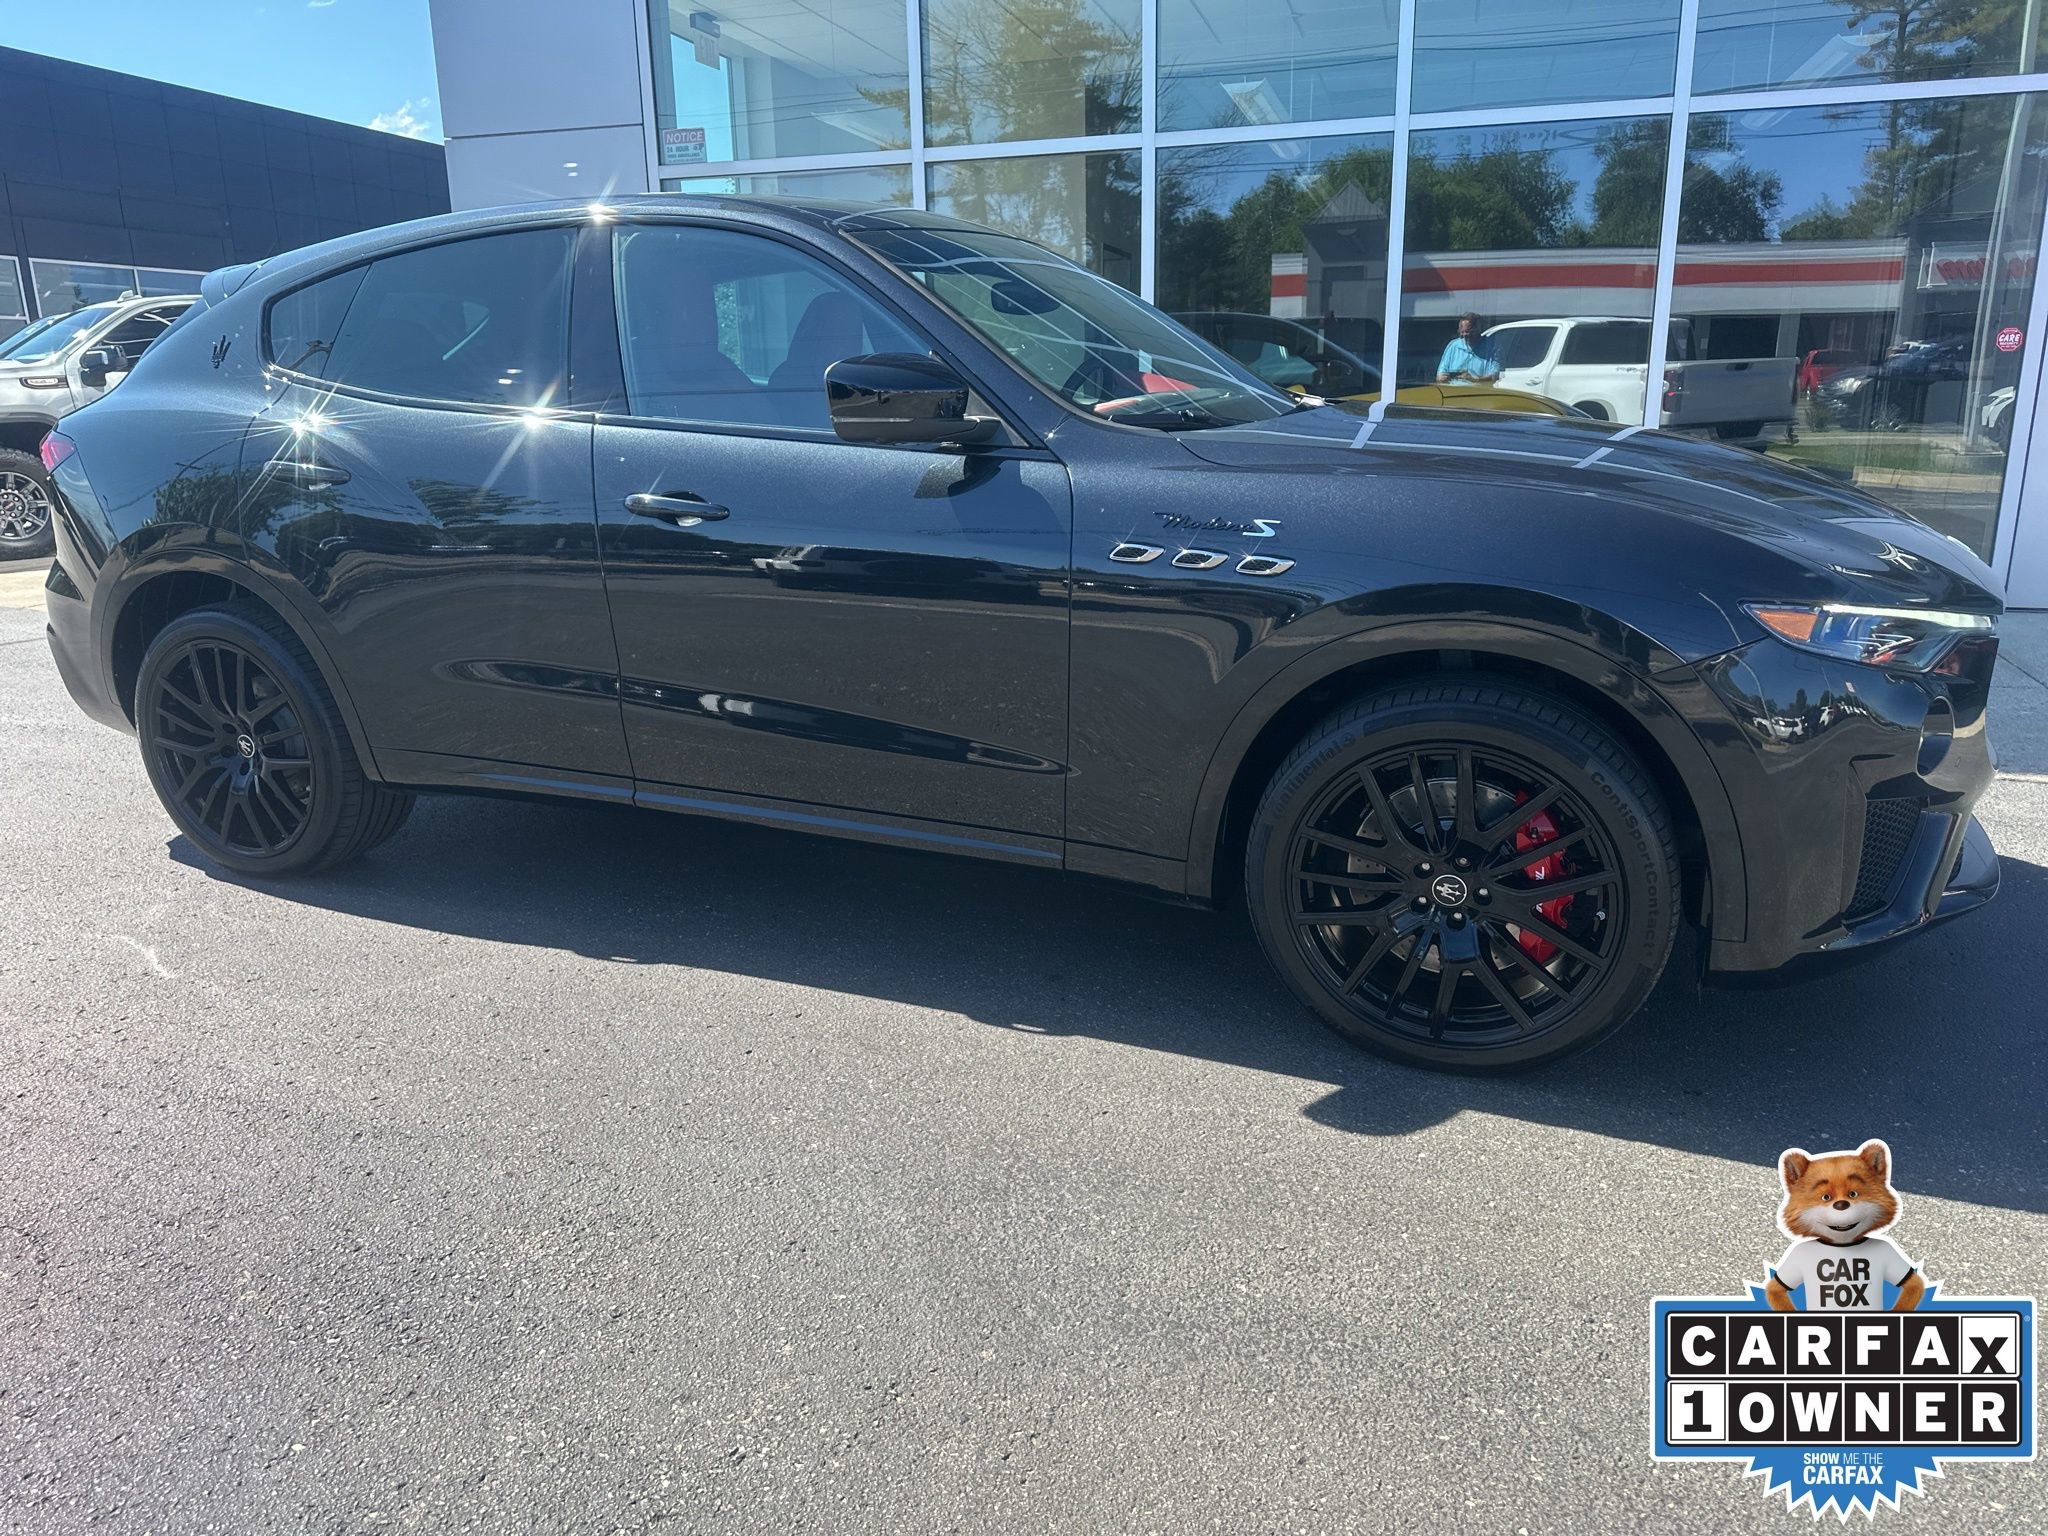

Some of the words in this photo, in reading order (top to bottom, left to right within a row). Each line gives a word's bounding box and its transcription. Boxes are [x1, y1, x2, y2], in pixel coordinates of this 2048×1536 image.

[666, 131, 703, 143] NOTICE
[1999, 333, 2020, 341] CARE
[1242, 519, 1281, 537] S
